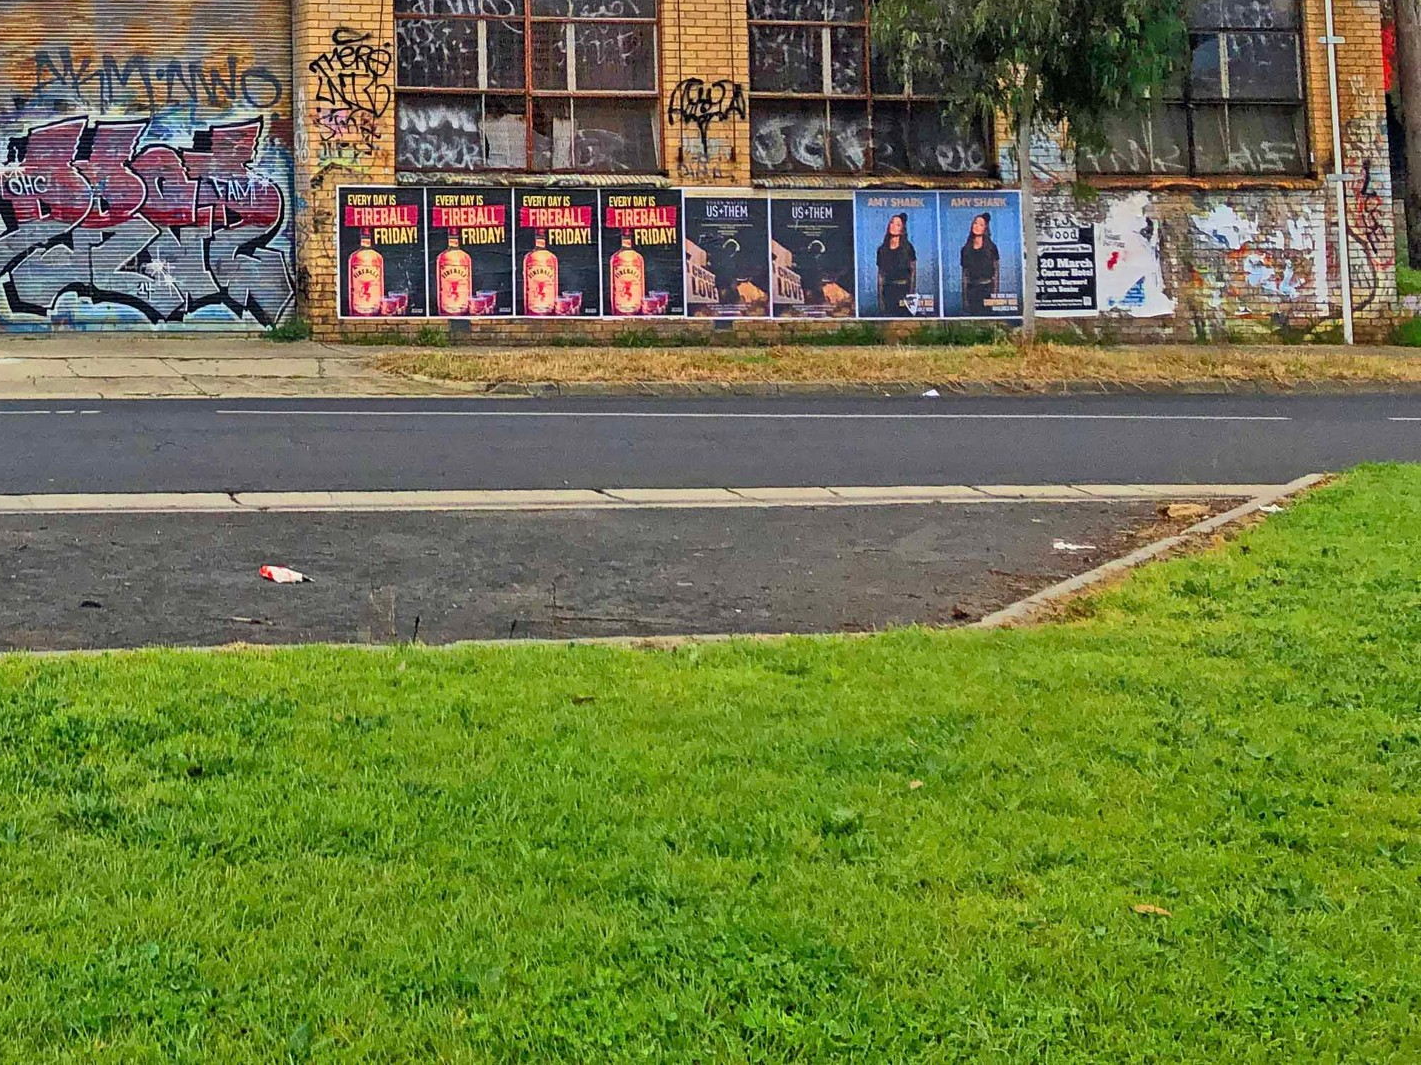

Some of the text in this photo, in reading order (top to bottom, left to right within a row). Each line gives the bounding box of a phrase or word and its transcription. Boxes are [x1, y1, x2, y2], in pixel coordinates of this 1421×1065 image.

[348, 195, 396, 205] EVERY DAY IS
[435, 195, 484, 206] EVERY DAY IS
[523, 196, 570, 206] EVERY DAY IS
[609, 196, 656, 207] EVERY DAY IS
[867, 197, 925, 207] AMY SHARK
[951, 198, 1007, 207] AMY SHARK
[354, 207, 411, 226] FIREBALL
[442, 207, 498, 226] FIREBALL
[529, 208, 585, 226] FIREBALL
[615, 208, 670, 227] FIREBALL
[706, 205, 748, 218] US+THEM
[791, 207, 833, 219] US+THEM
[374, 227, 418, 244] FRIDAY!
[461, 227, 505, 244] FRIDAY!
[548, 228, 591, 245] FRIDAY!
[634, 228, 676, 245] FRIDAY!
[1040, 258, 1093, 268] 20 March
